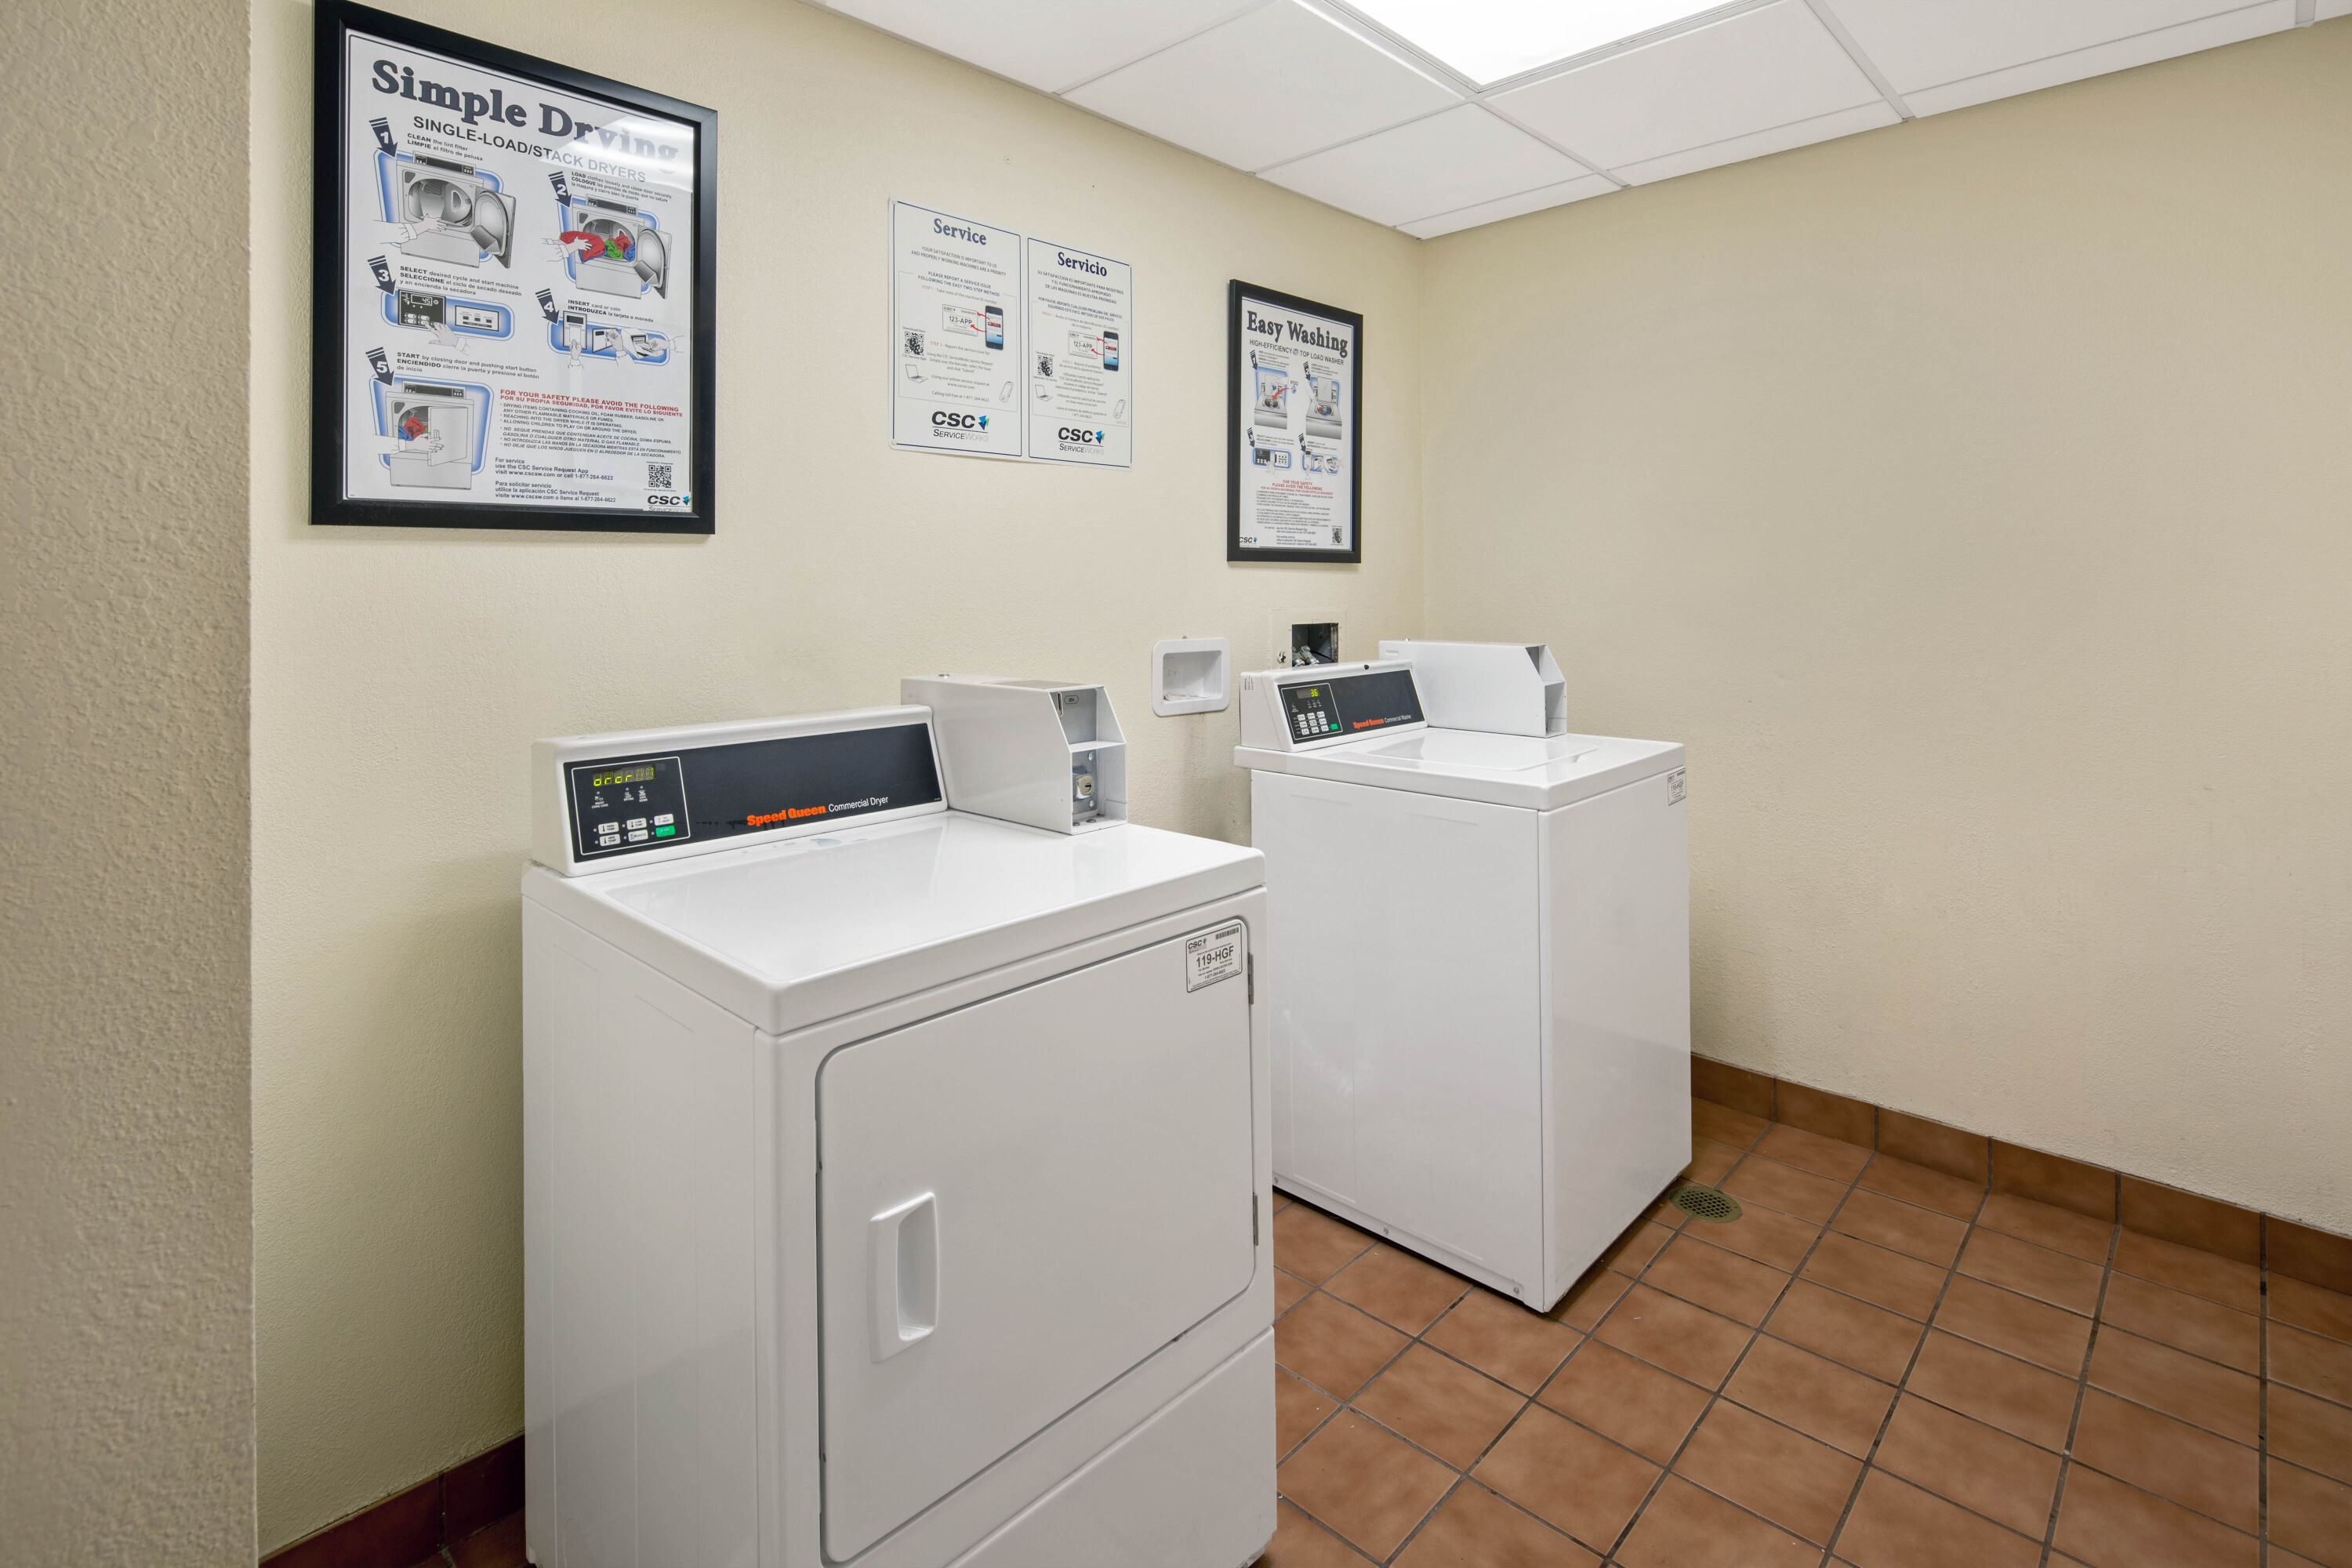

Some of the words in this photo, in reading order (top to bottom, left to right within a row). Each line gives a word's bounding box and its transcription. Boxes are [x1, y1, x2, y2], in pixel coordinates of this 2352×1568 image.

[372, 60, 526, 127] Simple
[380, 132, 389, 143] 1
[407, 133, 431, 142] CLEAN
[407, 140, 431, 148] LIMPIE
[588, 160, 646, 182] DRYERS
[557, 184, 566, 195] 2
[934, 218, 986, 245] Service
[1058, 252, 1107, 276] Servicio
[379, 270, 389, 281] 3
[400, 273, 445, 283] SELECCIONE
[544, 302, 554, 312] 4
[568, 306, 607, 314] INTRODUZCA
[949, 316, 972, 325] 123-APP
[1247, 310, 1283, 343] Easy
[1287, 321, 1348, 358] Washing
[1250, 339, 1293, 354] HIGH-EFFICIENCY
[1311, 352, 1323, 361] LOAD
[1325, 354, 1344, 365] WASHER
[376, 361, 387, 373] 5
[932, 412, 975, 428] CSC
[1058, 427, 1093, 443] CSC
[648, 495, 680, 505] CSC
[747, 810, 786, 826] Speed
[788, 805, 826, 818] Queen
[829, 799, 869, 812] Commercial
[870, 797, 888, 806] Dryer
[1189, 940, 1202, 949] CSC
[1196, 946, 1233, 967] 119-HGF
